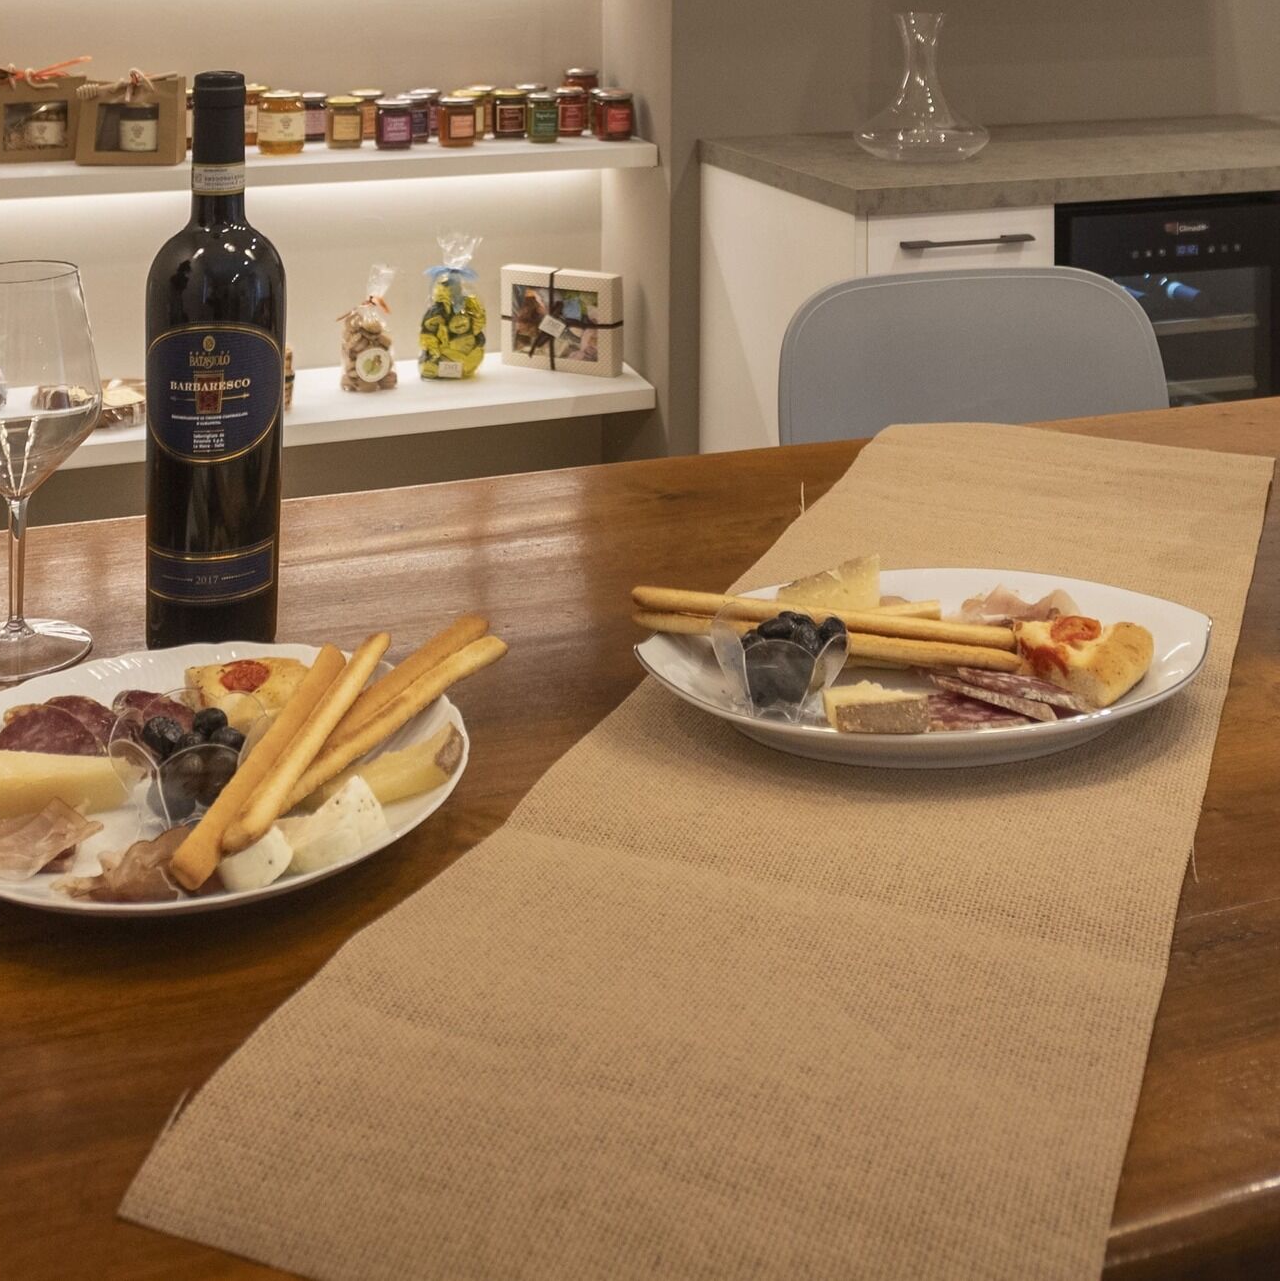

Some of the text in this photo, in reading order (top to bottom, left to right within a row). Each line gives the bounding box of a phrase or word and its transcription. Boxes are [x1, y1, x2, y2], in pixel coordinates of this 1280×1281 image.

[189, 354, 231, 369] BATASIOLO
[170, 378, 251, 392] BARBARESCO
[195, 575, 220, 585] 2017
